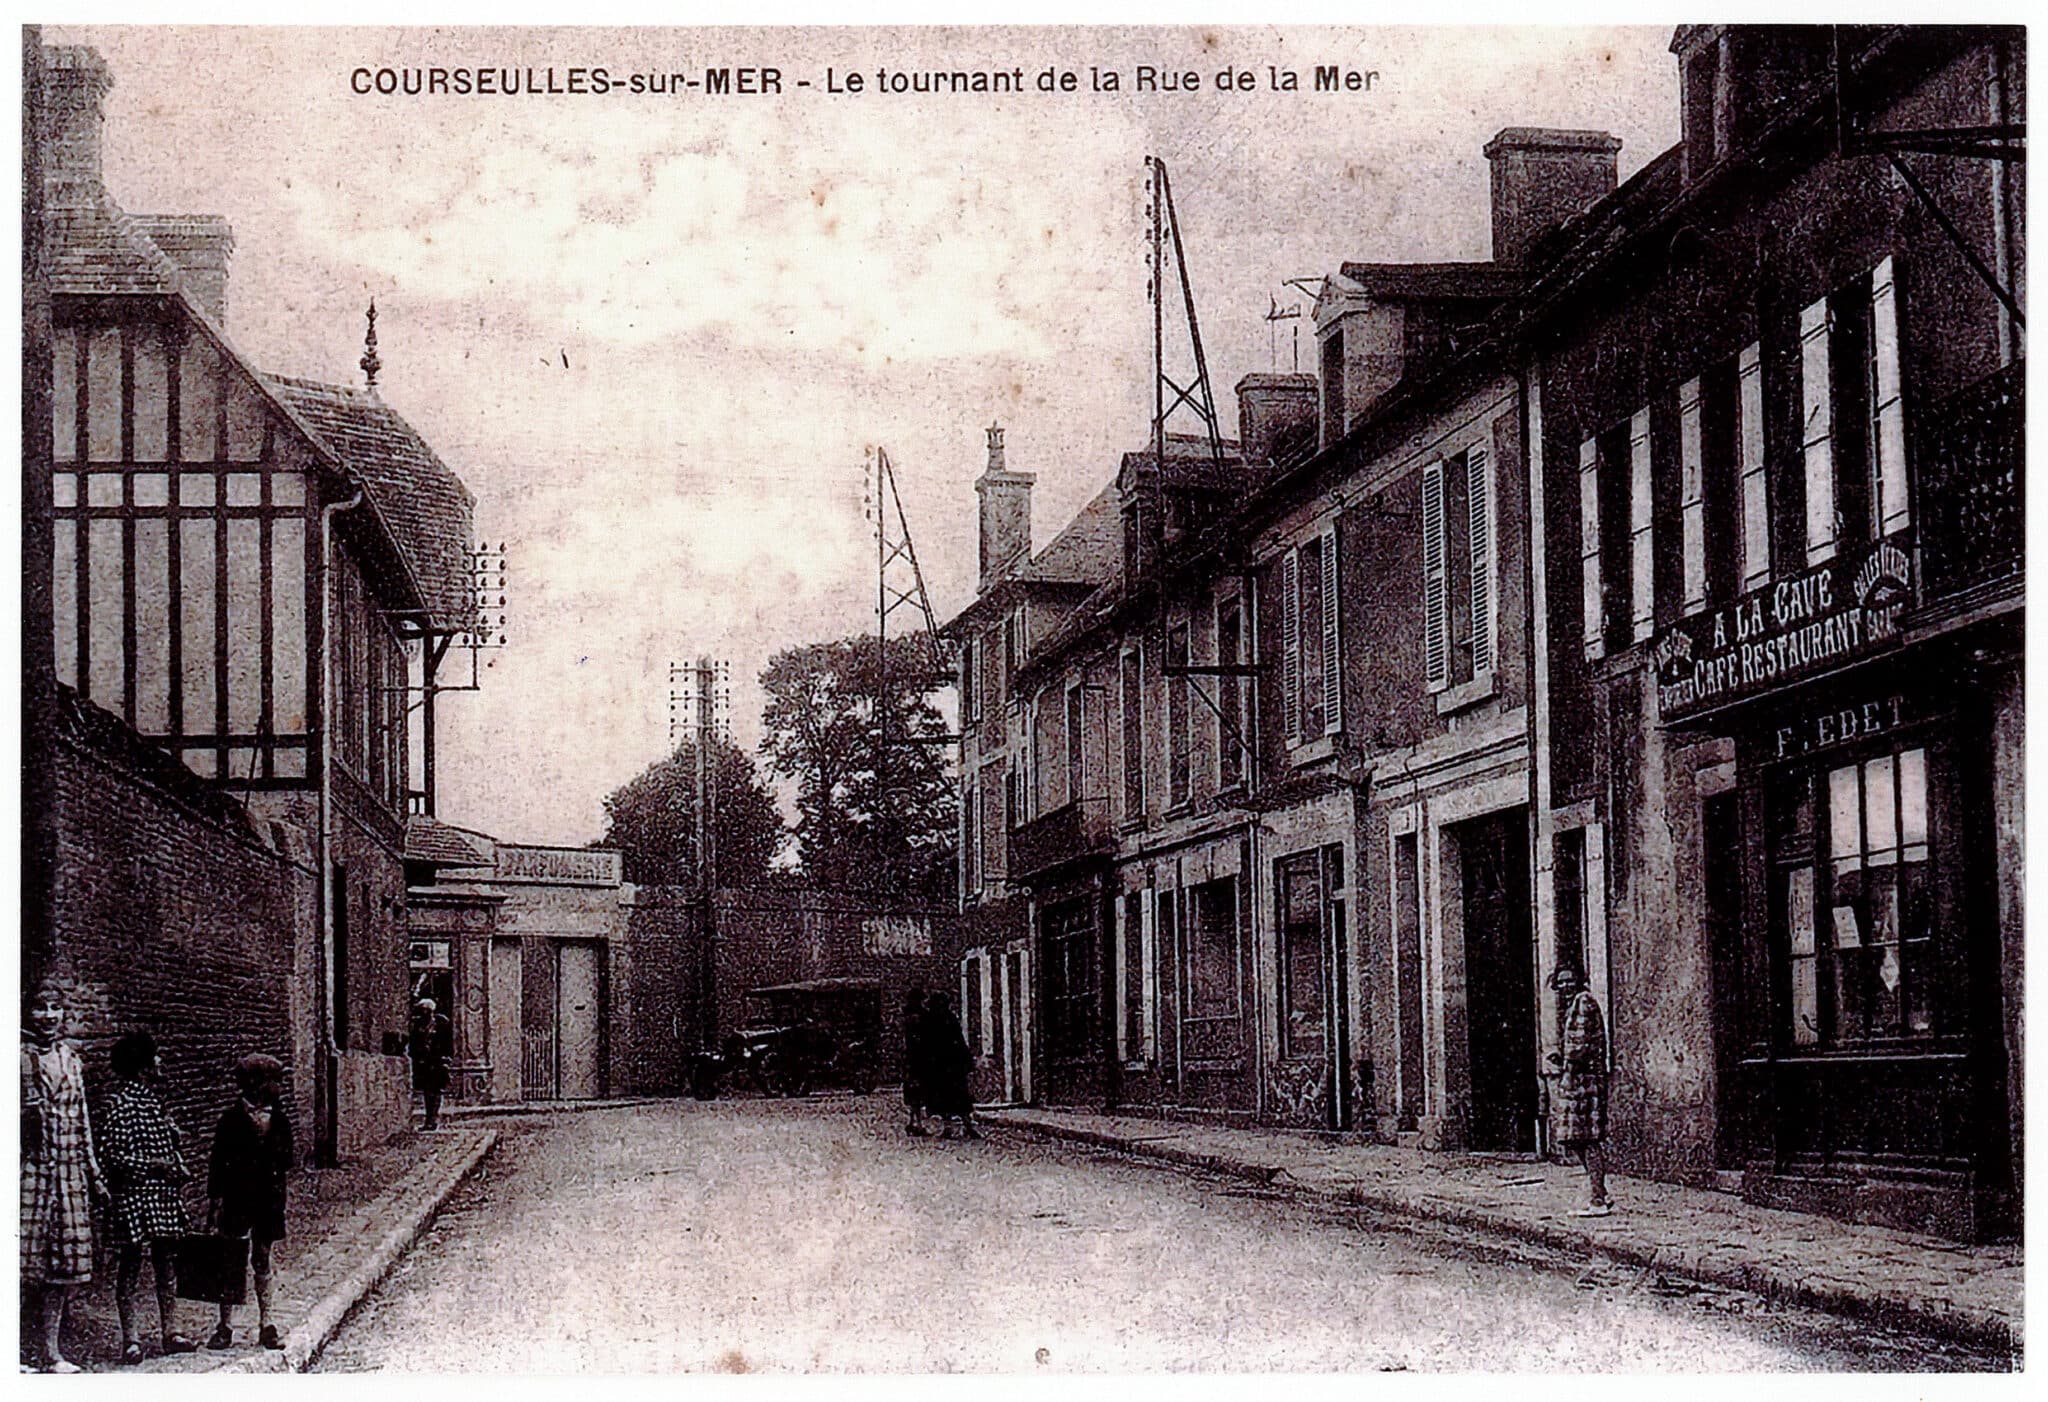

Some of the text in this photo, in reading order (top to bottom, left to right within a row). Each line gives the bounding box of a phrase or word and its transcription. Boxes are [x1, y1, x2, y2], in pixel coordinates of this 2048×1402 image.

[1713, 611, 1727, 649] A
[1735, 597, 1766, 642] LA
[1773, 568, 1834, 626] CAVE
[1741, 607, 1863, 684] RESTAURANT
[1817, 695, 1905, 747] EDET
